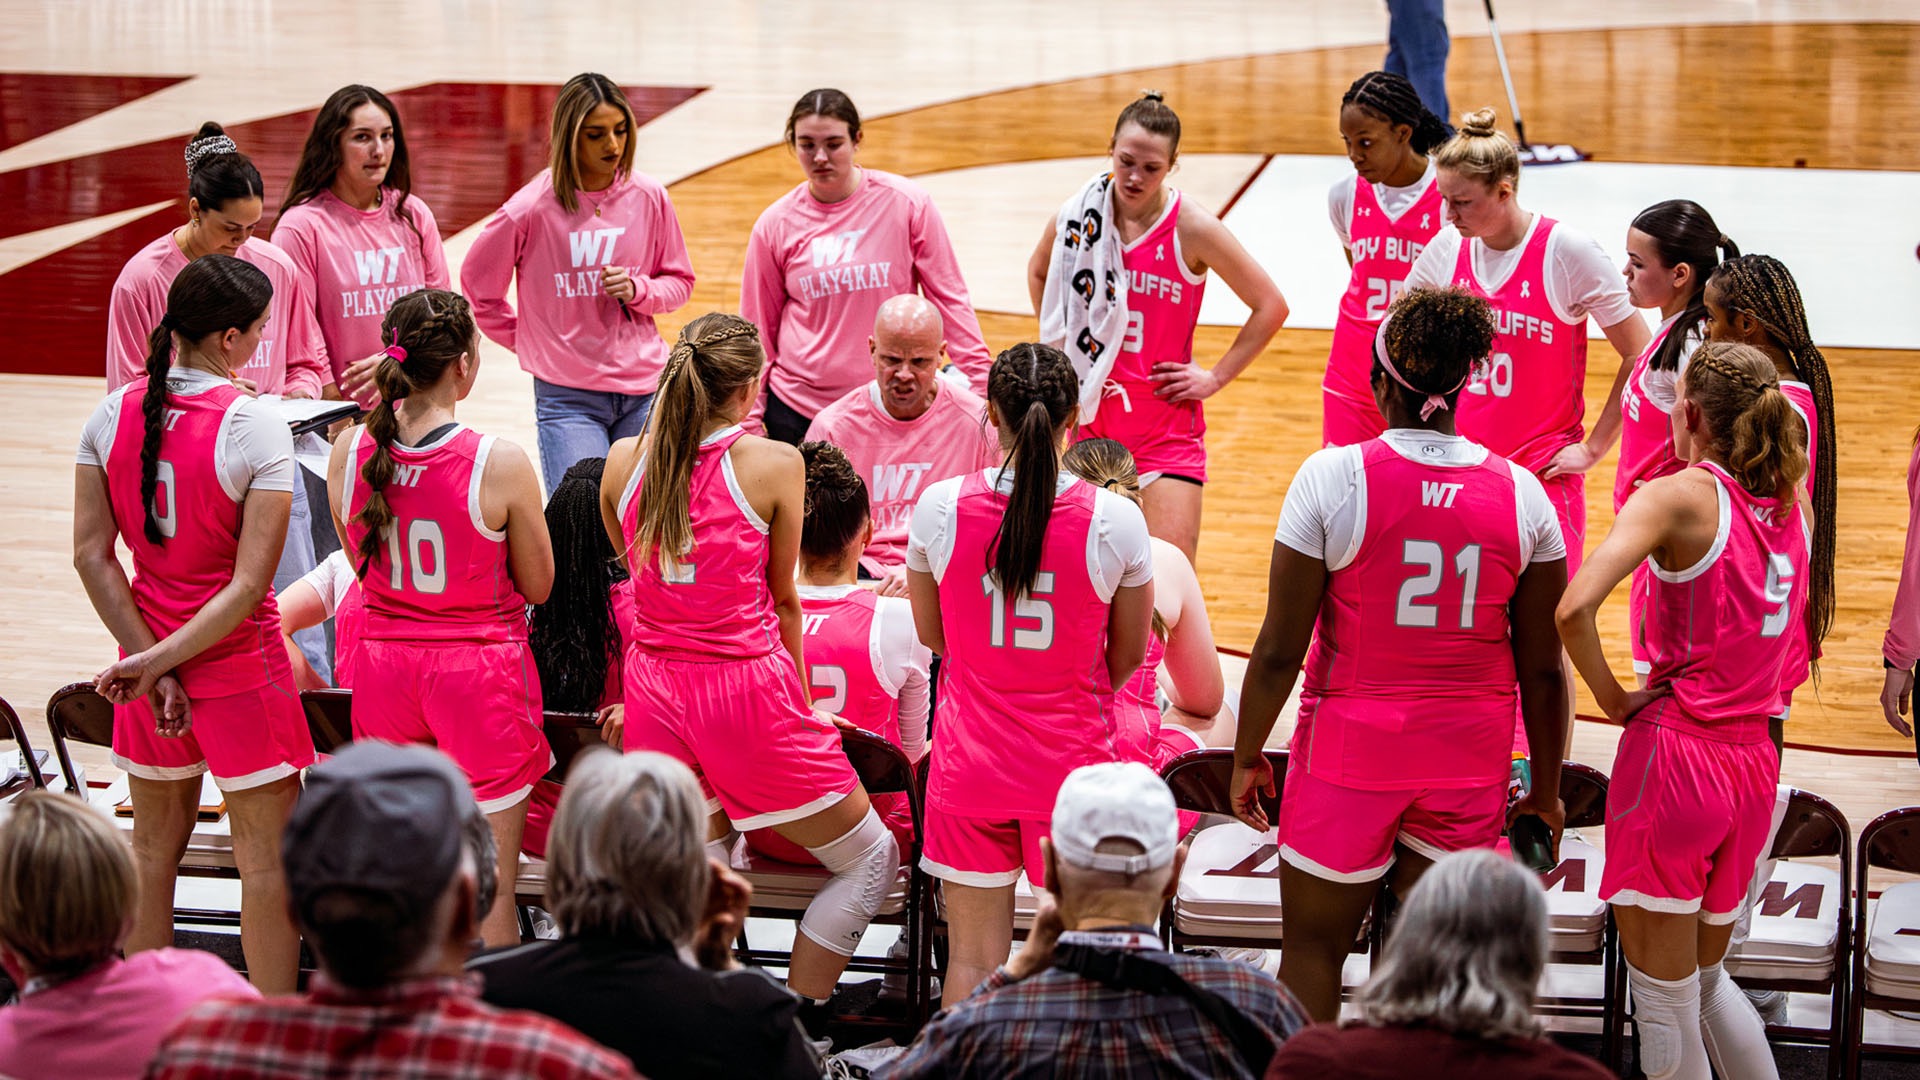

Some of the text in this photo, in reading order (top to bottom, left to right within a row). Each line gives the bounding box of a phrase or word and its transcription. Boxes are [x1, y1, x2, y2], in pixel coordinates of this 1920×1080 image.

[354, 246, 405, 286] WT
[569, 227, 626, 267] WT
[811, 228, 868, 269] WT
[1351, 236, 1425, 264] DY BUF
[341, 284, 425, 319] PLAY4
[800, 262, 891, 301] PLAY4KAY
[1488, 307, 1554, 345] UFFS
[392, 463, 428, 488] WT
[872, 462, 934, 502] WT
[1421, 480, 1465, 509] WT
[379, 515, 448, 595] 10
[1395, 538, 1482, 630] 21
[1760, 551, 1796, 638] 5
[979, 567, 1056, 652] 15
